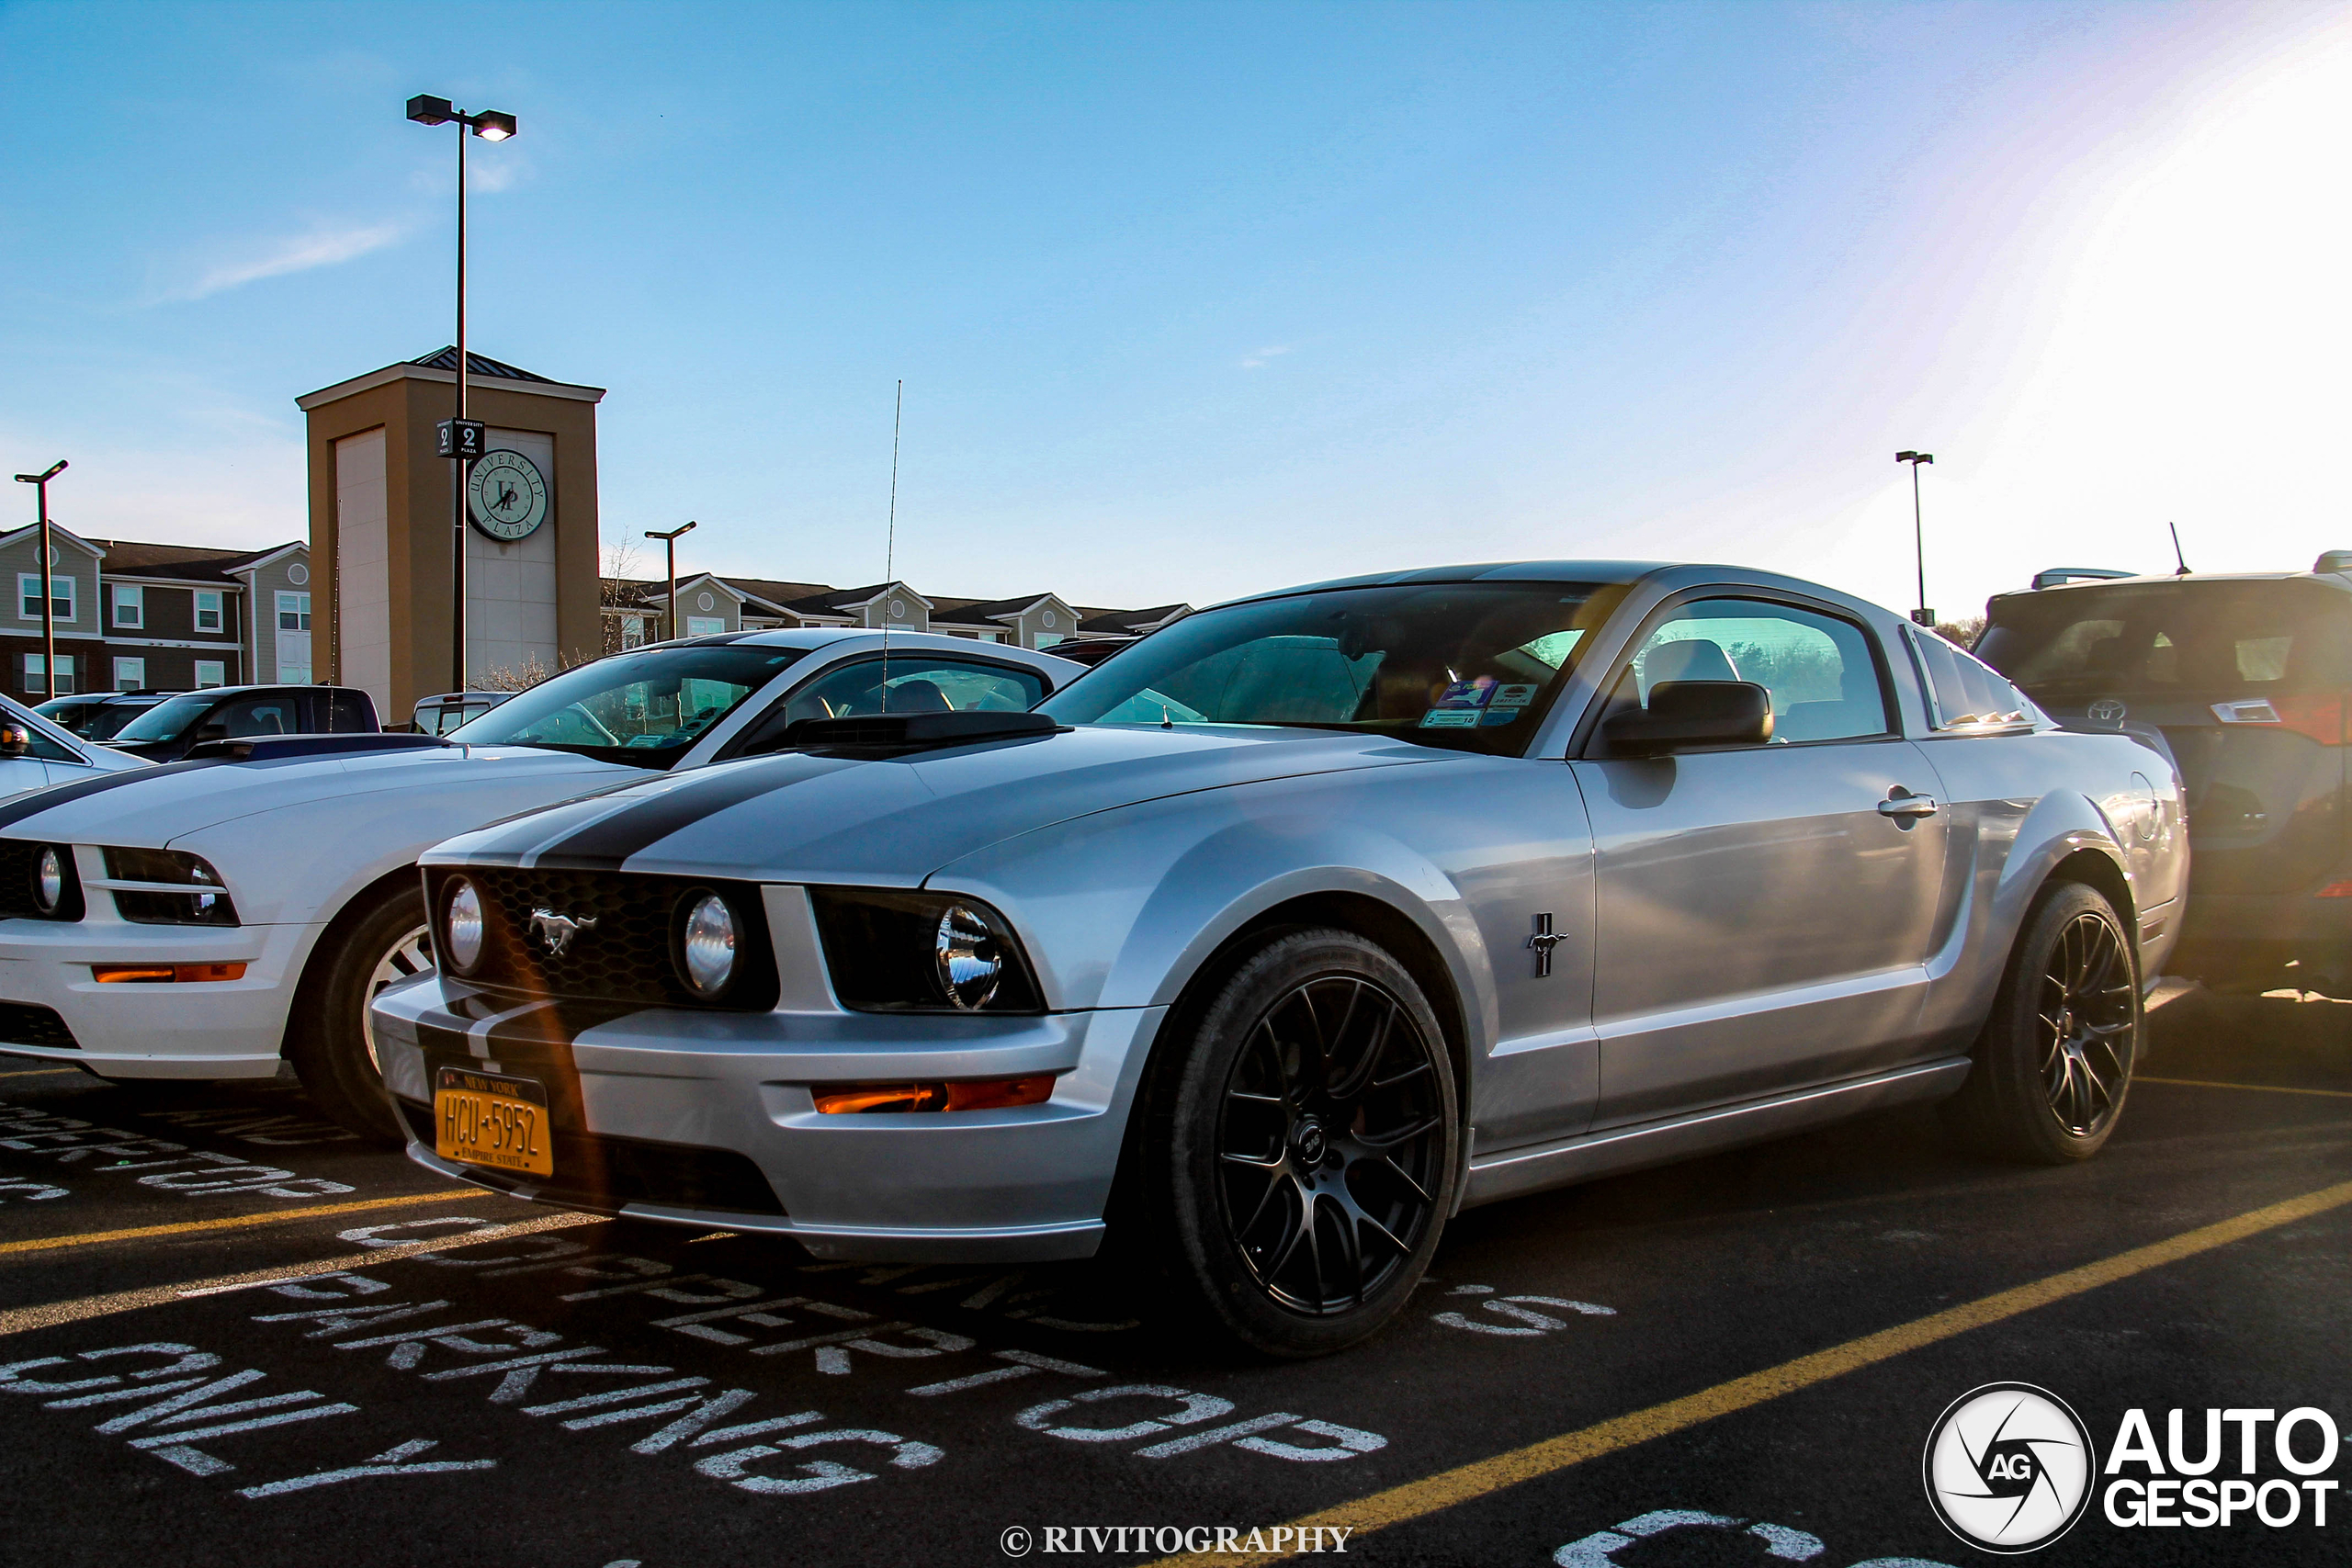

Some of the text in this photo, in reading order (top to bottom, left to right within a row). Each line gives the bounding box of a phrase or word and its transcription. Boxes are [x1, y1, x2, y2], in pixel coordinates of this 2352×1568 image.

[455, 420, 483, 428] UNIVERSITY
[441, 428, 448, 446] 2
[463, 427, 475, 446] 2
[470, 454, 544, 498] UNIVERSITY
[482, 515, 534, 536] PLAZA
[464, 1076, 519, 1097] NEW YORK
[462, 1147, 523, 1168] EMPIRE STATE
[177, 1270, 946, 1495] PARKING
[0, 1341, 498, 1499] ONLY
